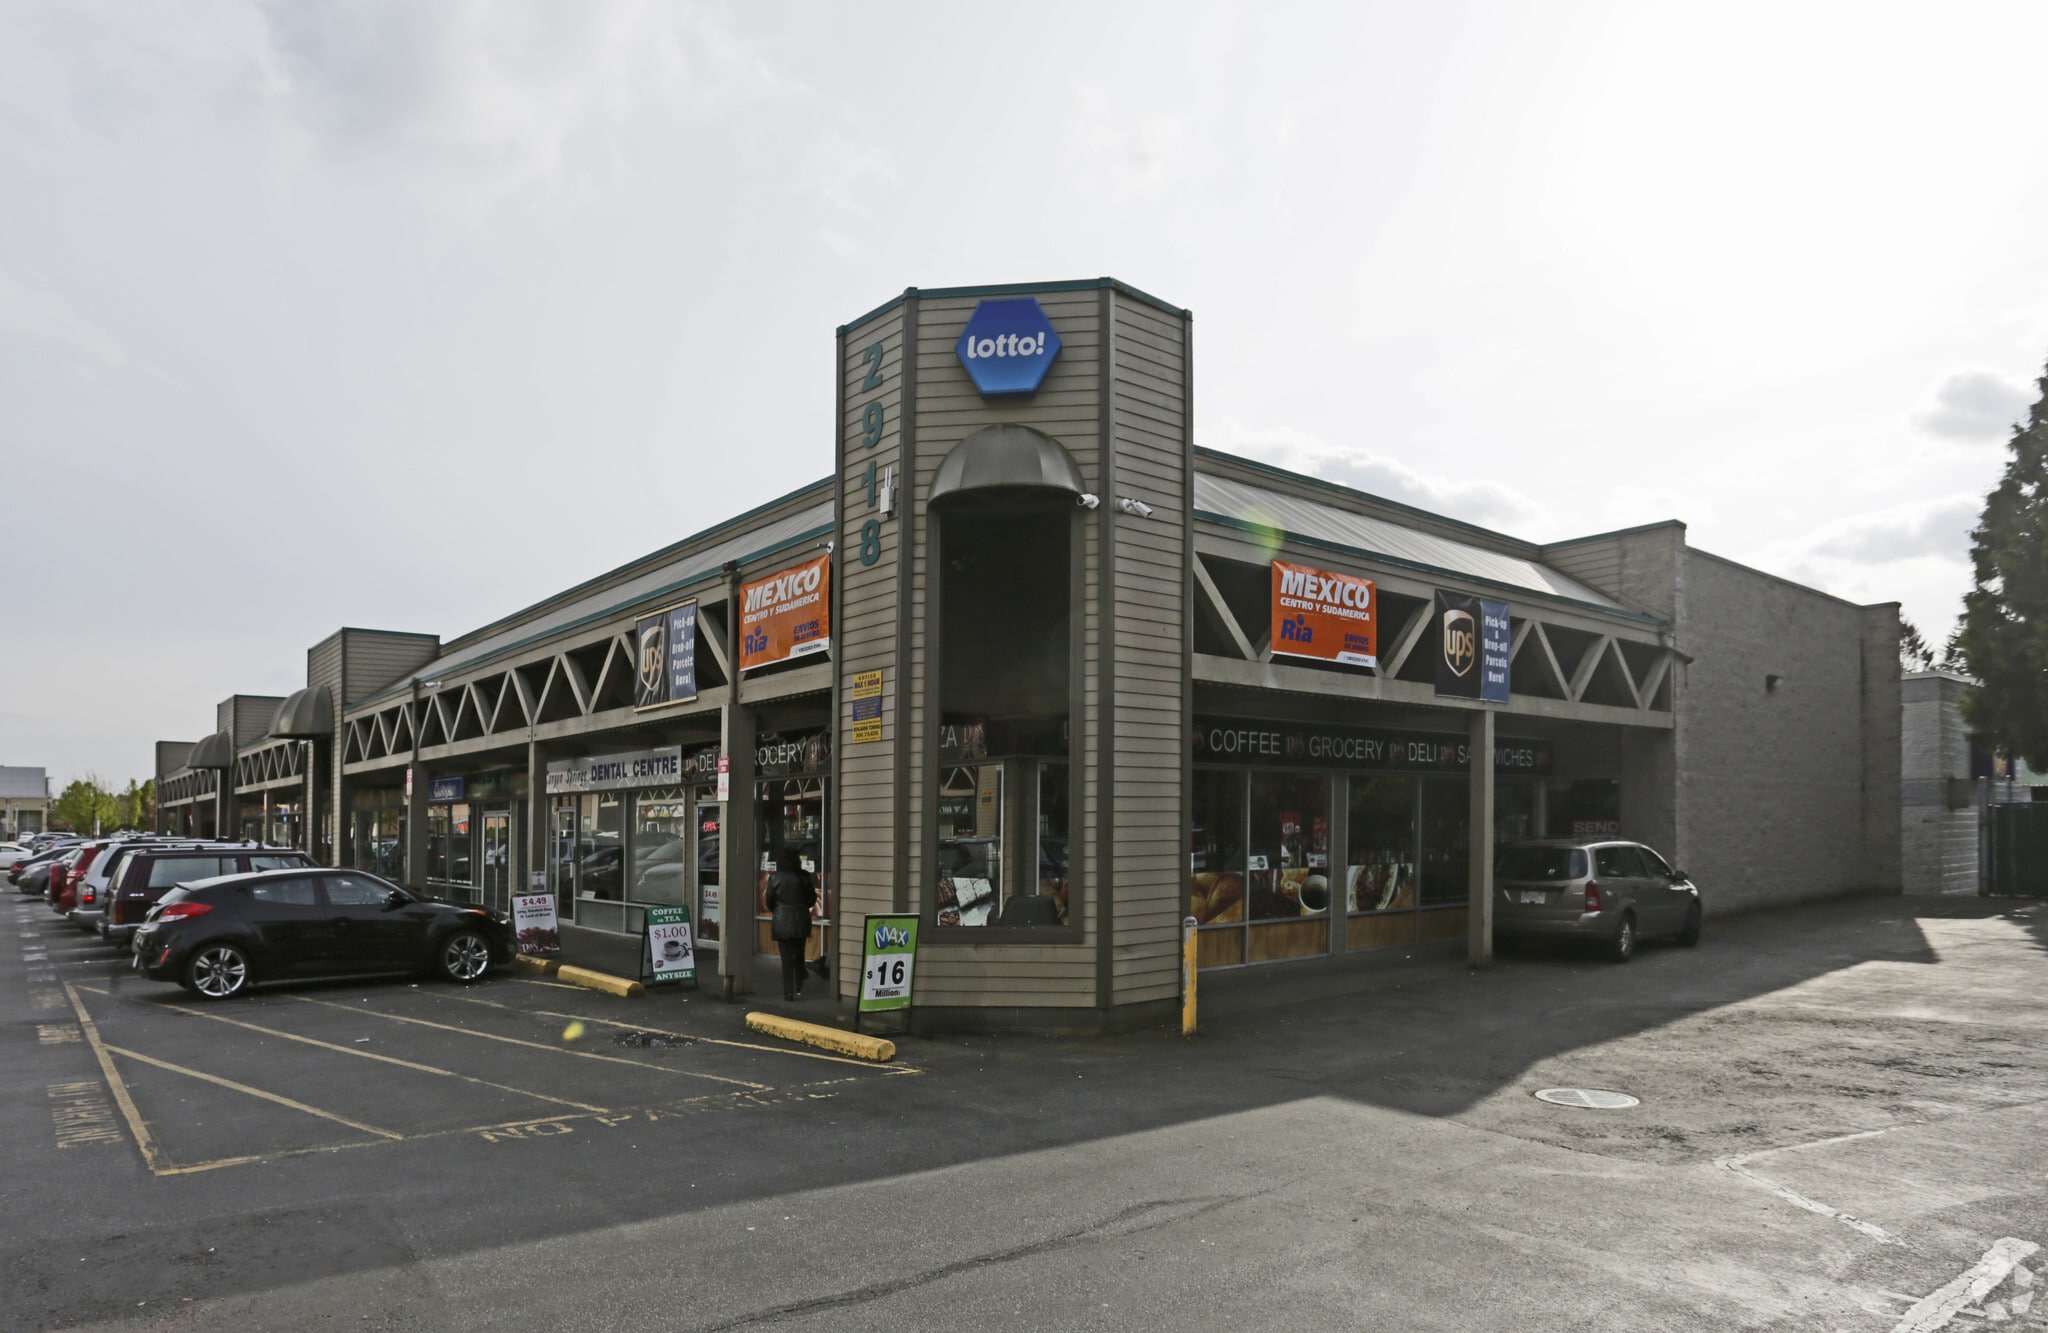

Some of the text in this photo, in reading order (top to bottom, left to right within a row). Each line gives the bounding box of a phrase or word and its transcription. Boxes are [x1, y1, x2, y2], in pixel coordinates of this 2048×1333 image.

[967, 332, 1045, 359] lotto!
[860, 343, 884, 567] 2918
[745, 566, 820, 612] MEXICO
[1281, 570, 1370, 609] MEXICO
[744, 593, 819, 624] CENTRO Y SUDAMERICA
[1280, 597, 1370, 621] CENTRO Y SUDAMERICA
[1281, 614, 1313, 642] Ria
[1486, 616, 1507, 630] Pick-up
[745, 625, 768, 656] Ria
[1447, 630, 1473, 666] ups
[1485, 639, 1508, 652] Drop-off
[673, 656, 693, 670] Parcels
[1486, 655, 1507, 668] Parcels
[754, 742, 806, 766] OCERY
[1210, 729, 1280, 754] COFFEE
[1309, 736, 1384, 760] GROCERY
[1409, 742, 1437, 762] DELI
[591, 762, 627, 781] DENTAL
[633, 755, 677, 778] CENTRE
[1574, 821, 1618, 833] SEND
[522, 897, 547, 906] $4.49
[652, 908, 684, 916] COFFEE
[654, 926, 687, 940] $1.00
[875, 926, 907, 948] MAX
[480, 1122, 574, 1143] NO
